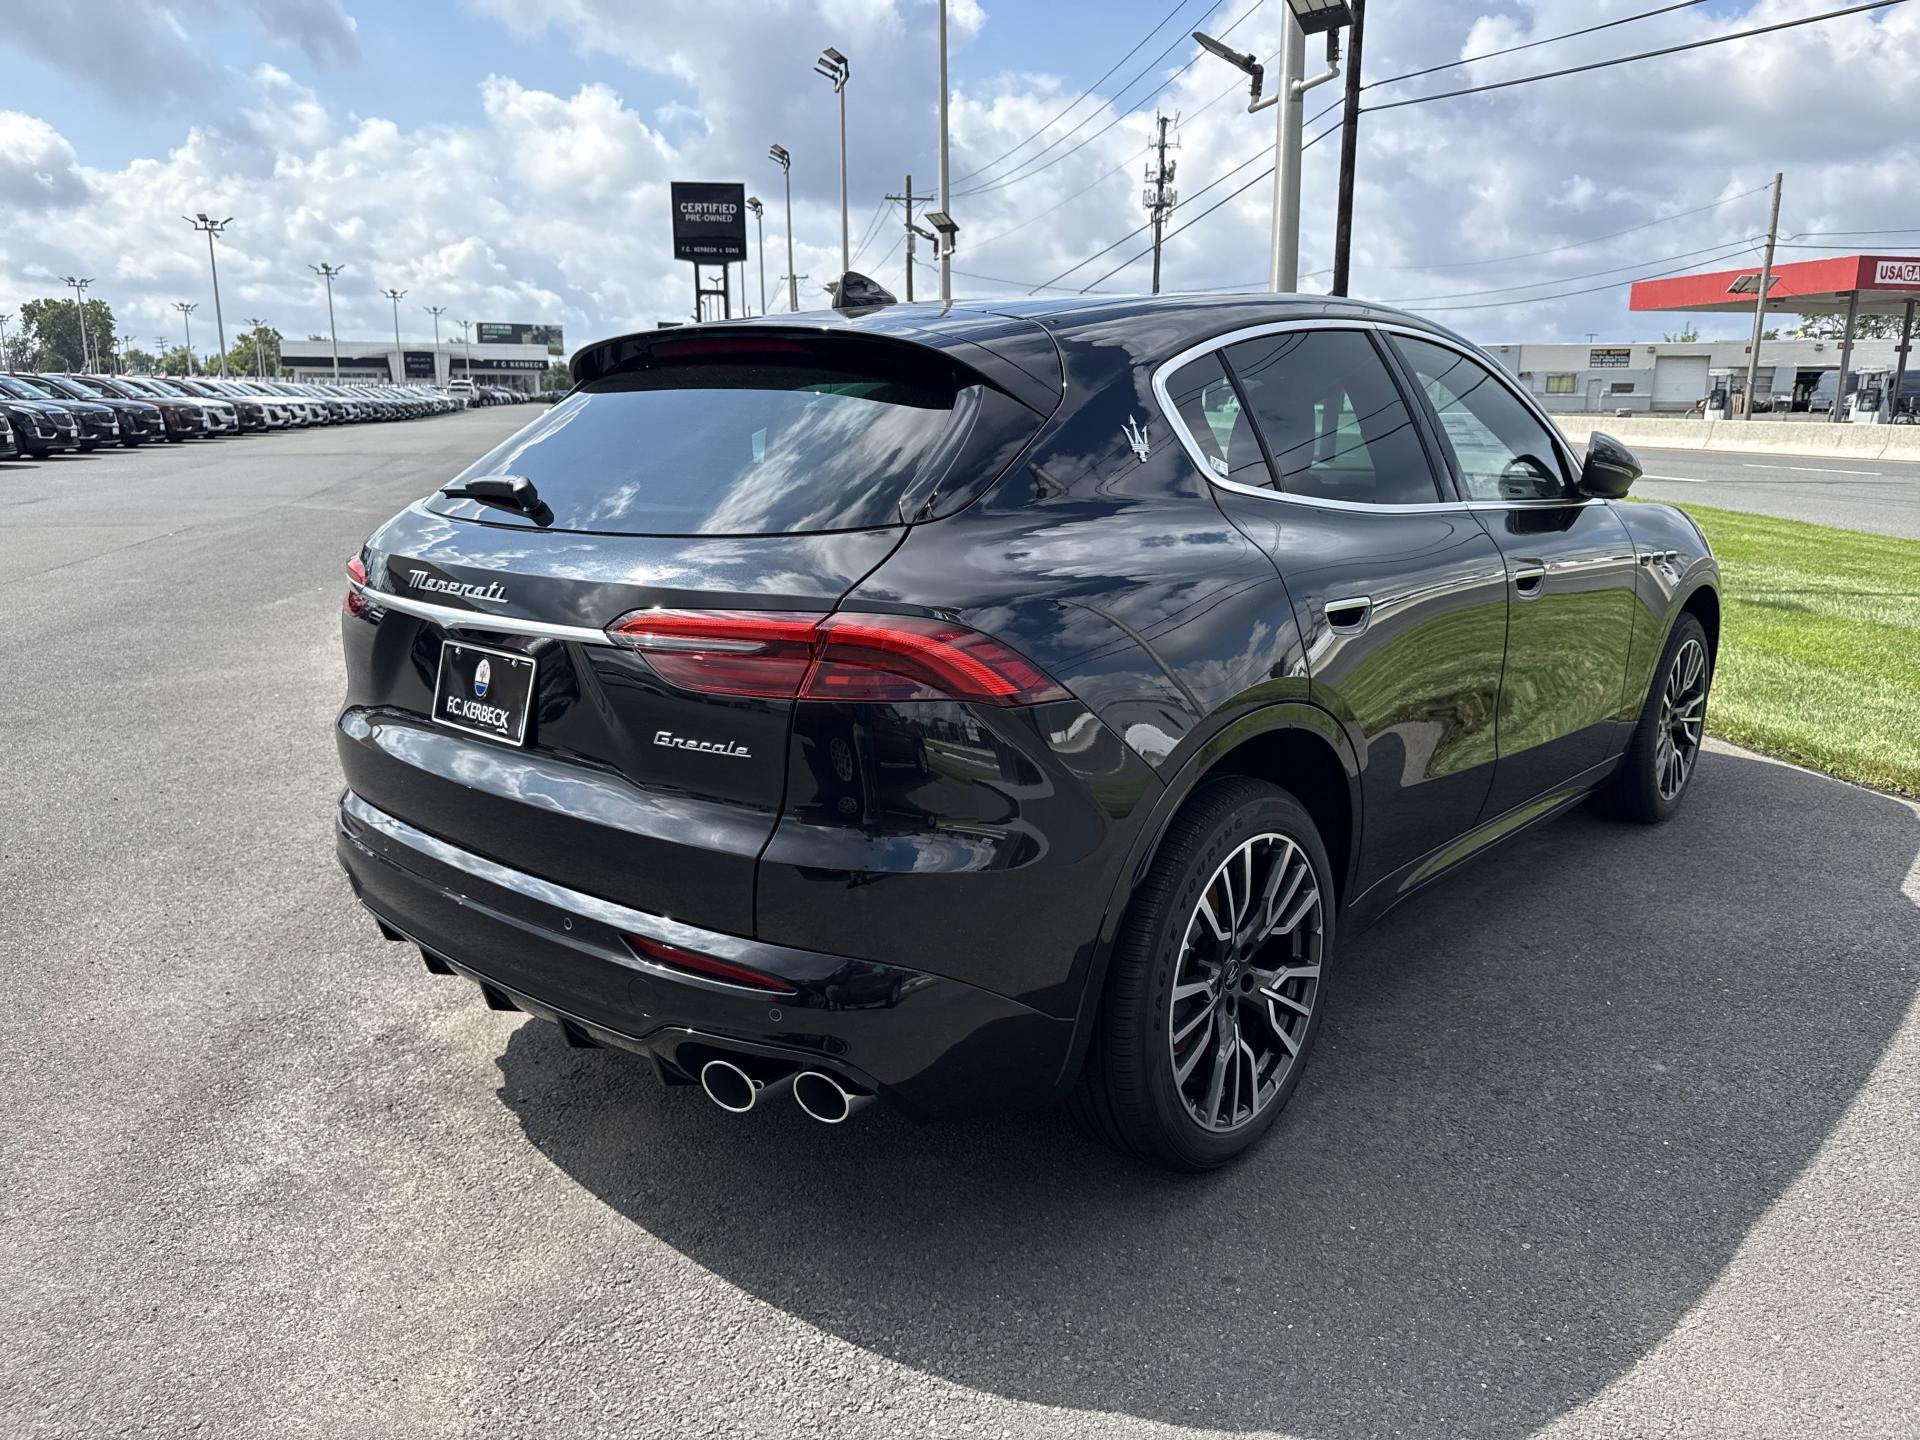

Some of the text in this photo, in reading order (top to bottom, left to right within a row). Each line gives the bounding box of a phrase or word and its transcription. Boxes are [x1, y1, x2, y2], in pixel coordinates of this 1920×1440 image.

[680, 202, 737, 214] CERTIFIED
[685, 214, 733, 222] PRE-OWNED
[510, 361, 544, 369] KERBECK
[409, 569, 509, 603] Maserati
[462, 700, 510, 729] KERBECK
[654, 731, 752, 758] Grecale
[1153, 816, 1244, 1032] EAGLE TOURING
